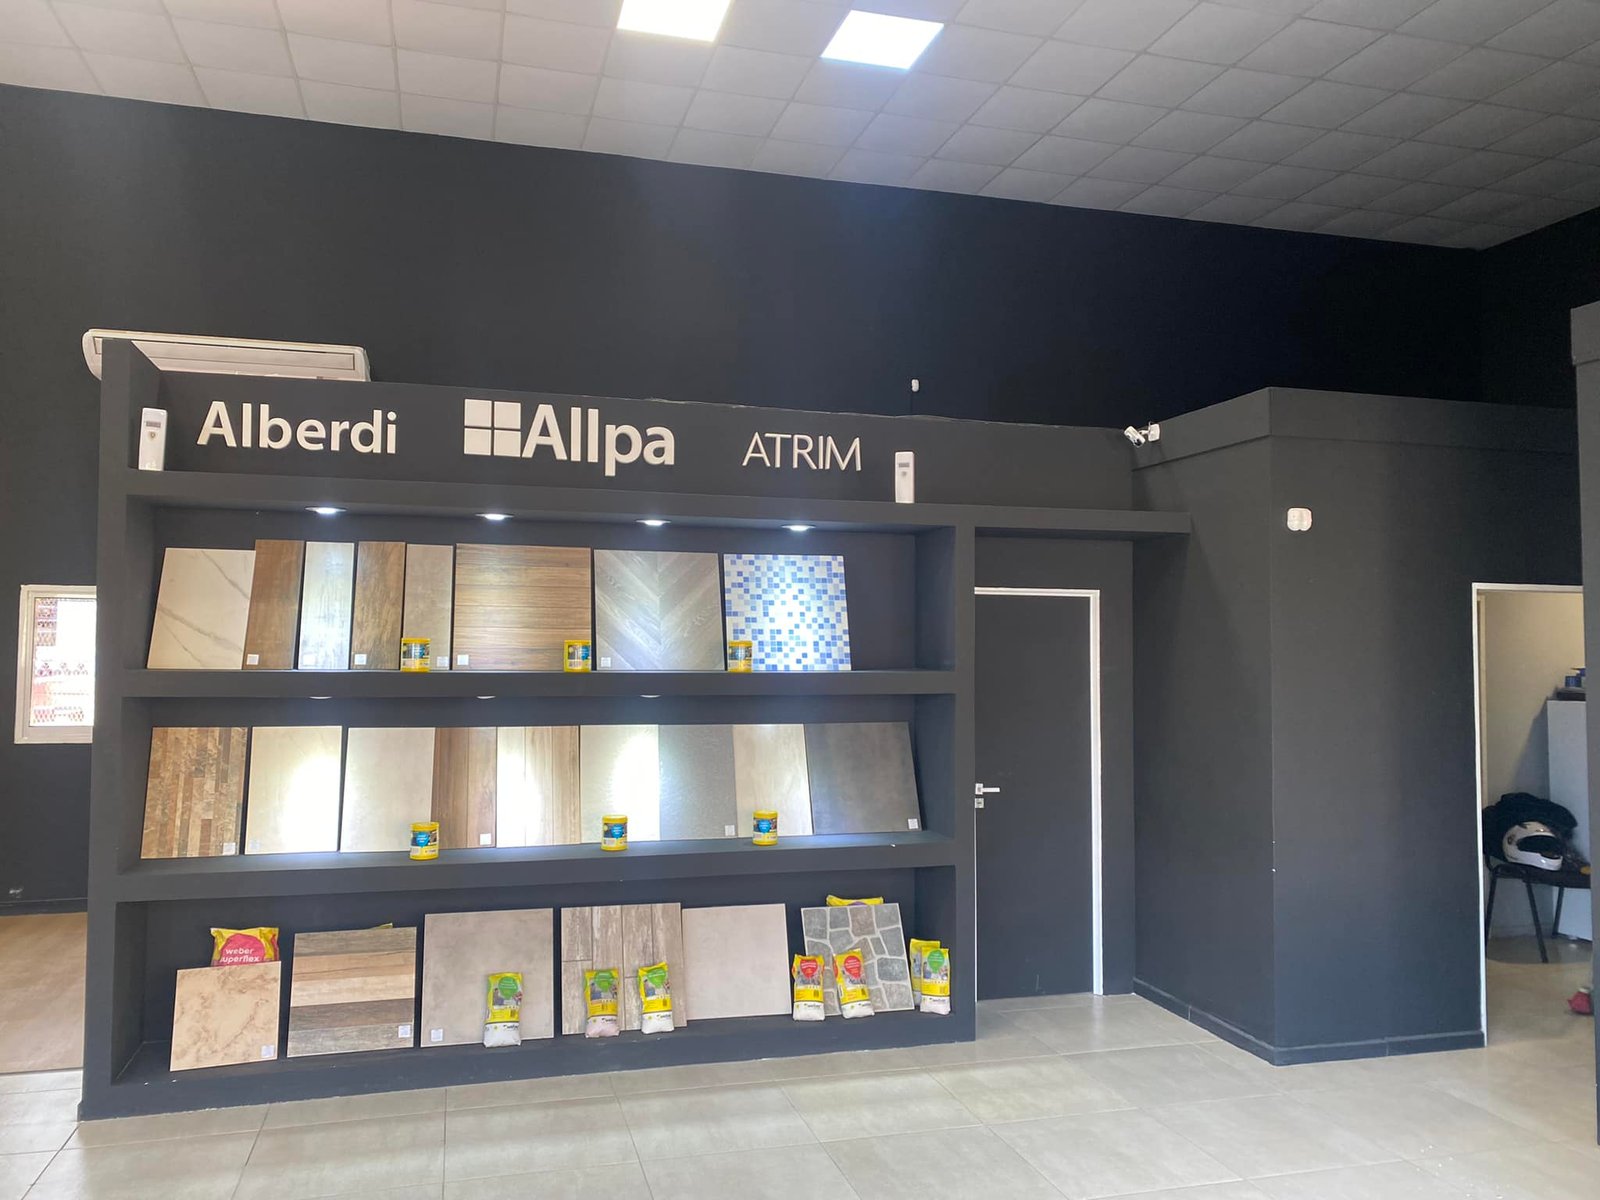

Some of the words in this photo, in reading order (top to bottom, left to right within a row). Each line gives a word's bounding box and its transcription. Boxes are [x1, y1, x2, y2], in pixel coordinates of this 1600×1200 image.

[196, 400, 397, 455] Alberdi
[522, 402, 676, 477] Allpa
[741, 431, 862, 471] ATRIM
[225, 947, 255, 955] weber
